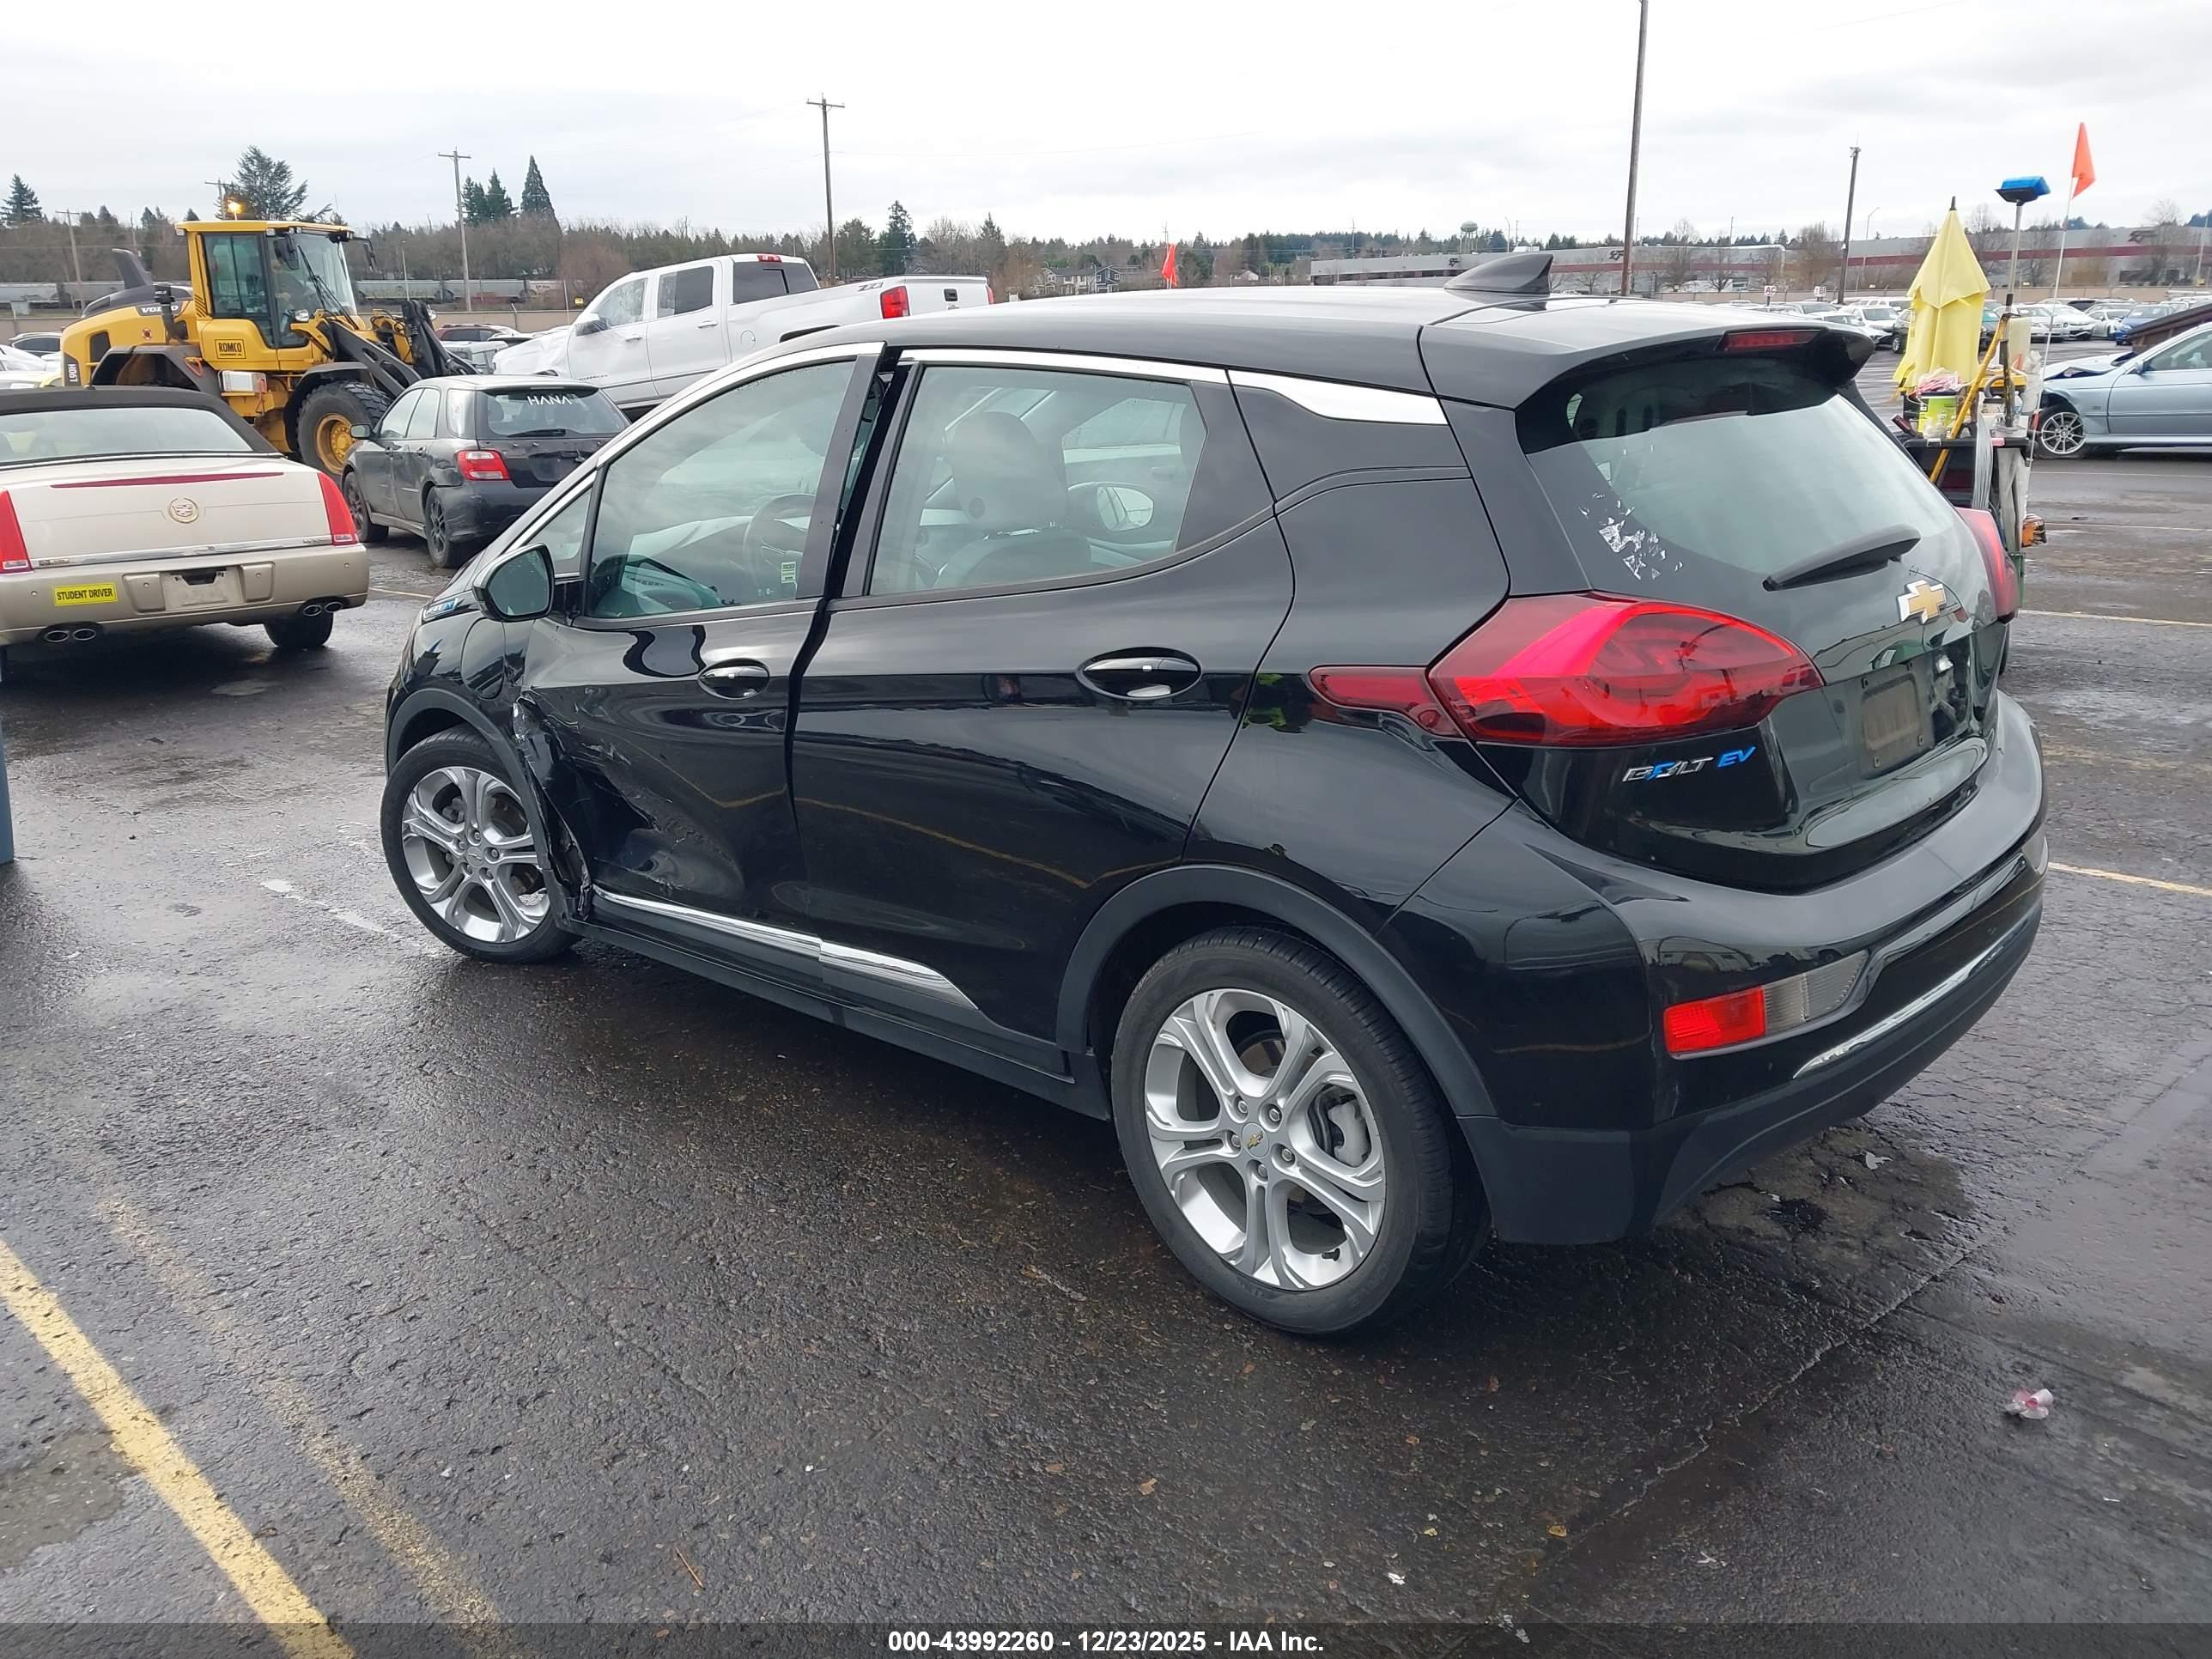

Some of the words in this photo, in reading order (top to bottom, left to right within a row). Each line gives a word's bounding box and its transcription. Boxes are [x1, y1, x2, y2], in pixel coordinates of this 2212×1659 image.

[141, 305, 179, 313] VOLO
[218, 343, 242, 352] ROMCO
[527, 395, 573, 406] HANA
[56, 590, 88, 601] STUDENT
[88, 588, 113, 599] DRIVER
[1622, 757, 1714, 782] BOLT
[1717, 746, 1756, 768] EV
